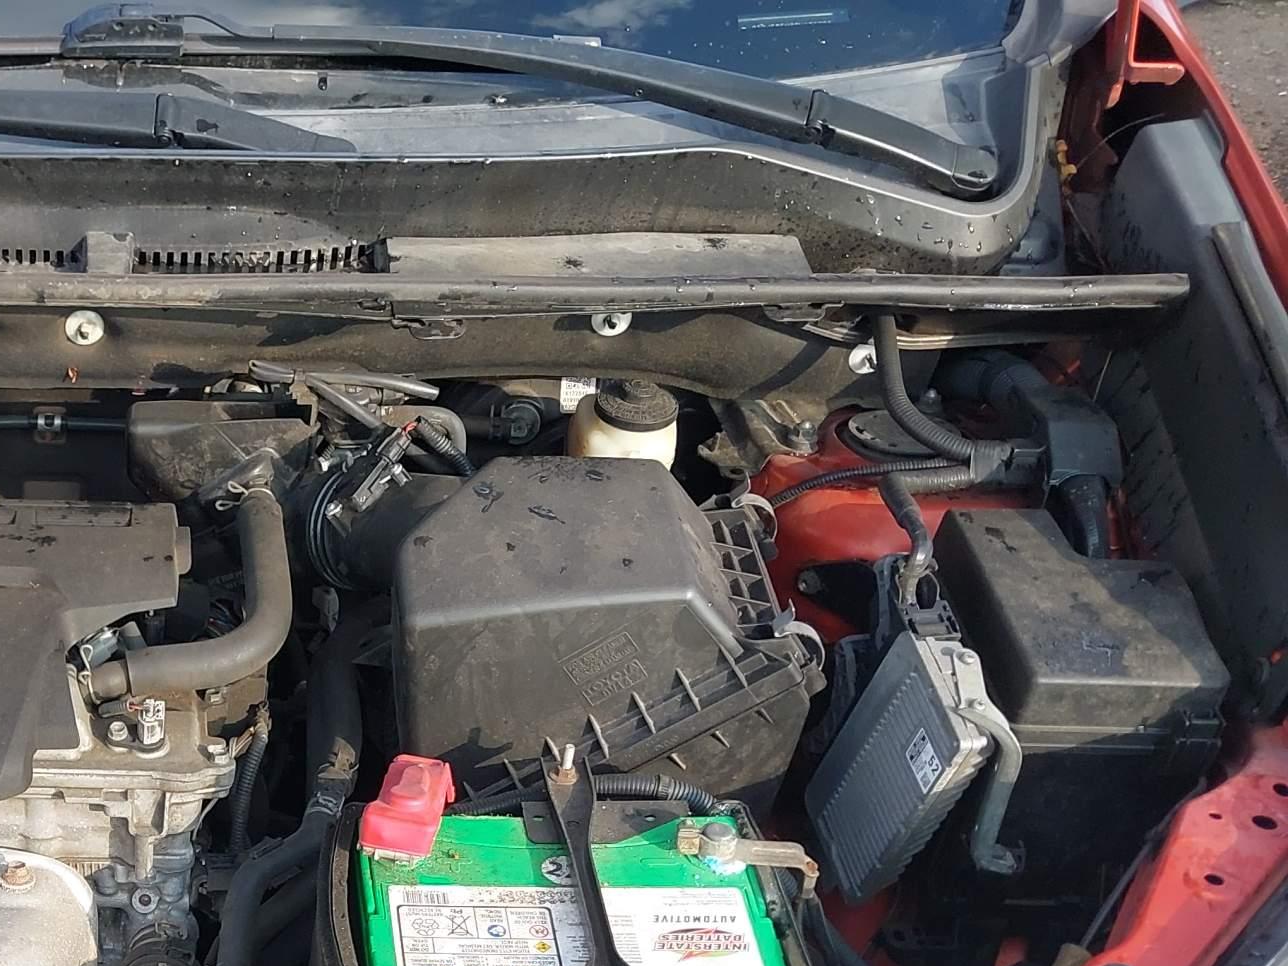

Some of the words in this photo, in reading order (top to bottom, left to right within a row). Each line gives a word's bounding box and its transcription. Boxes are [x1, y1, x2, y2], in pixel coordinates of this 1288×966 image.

[652, 915, 737, 923] AUTOMOTIVE
[659, 934, 743, 942] BATTERIES
[654, 942, 749, 951] INTERSTATE
